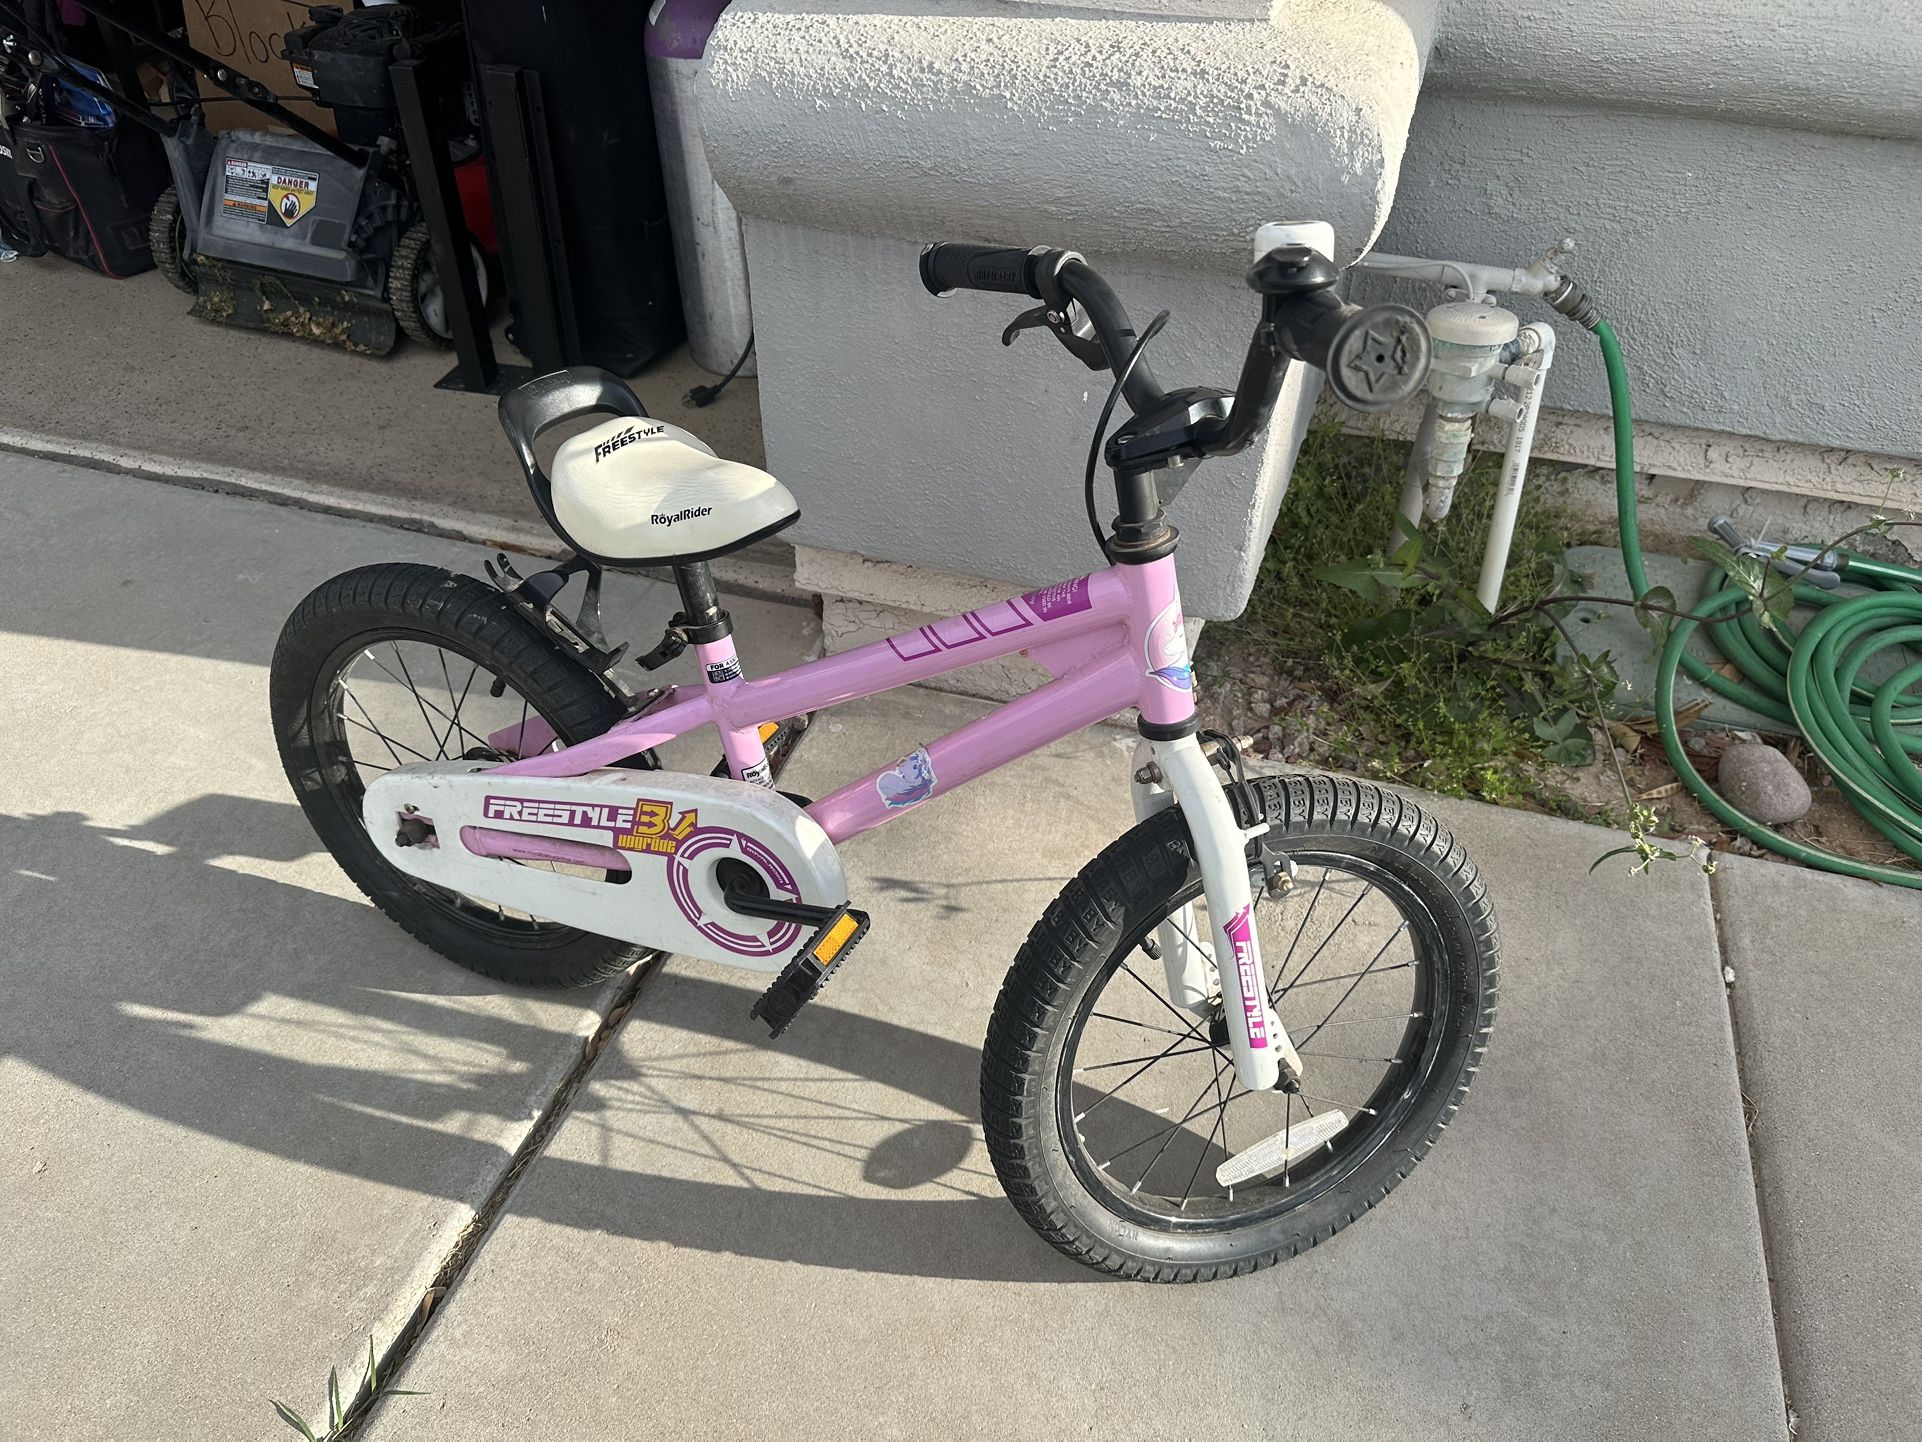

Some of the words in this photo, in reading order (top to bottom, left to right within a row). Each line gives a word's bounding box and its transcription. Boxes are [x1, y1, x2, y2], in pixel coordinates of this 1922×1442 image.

[276, 176, 310, 190] DANGER
[593, 425, 665, 464] FREESTYLE
[487, 799, 634, 830] FREESTYLE
[617, 834, 677, 854] upgrade
[1235, 942, 1265, 1039] FREESTYLE
